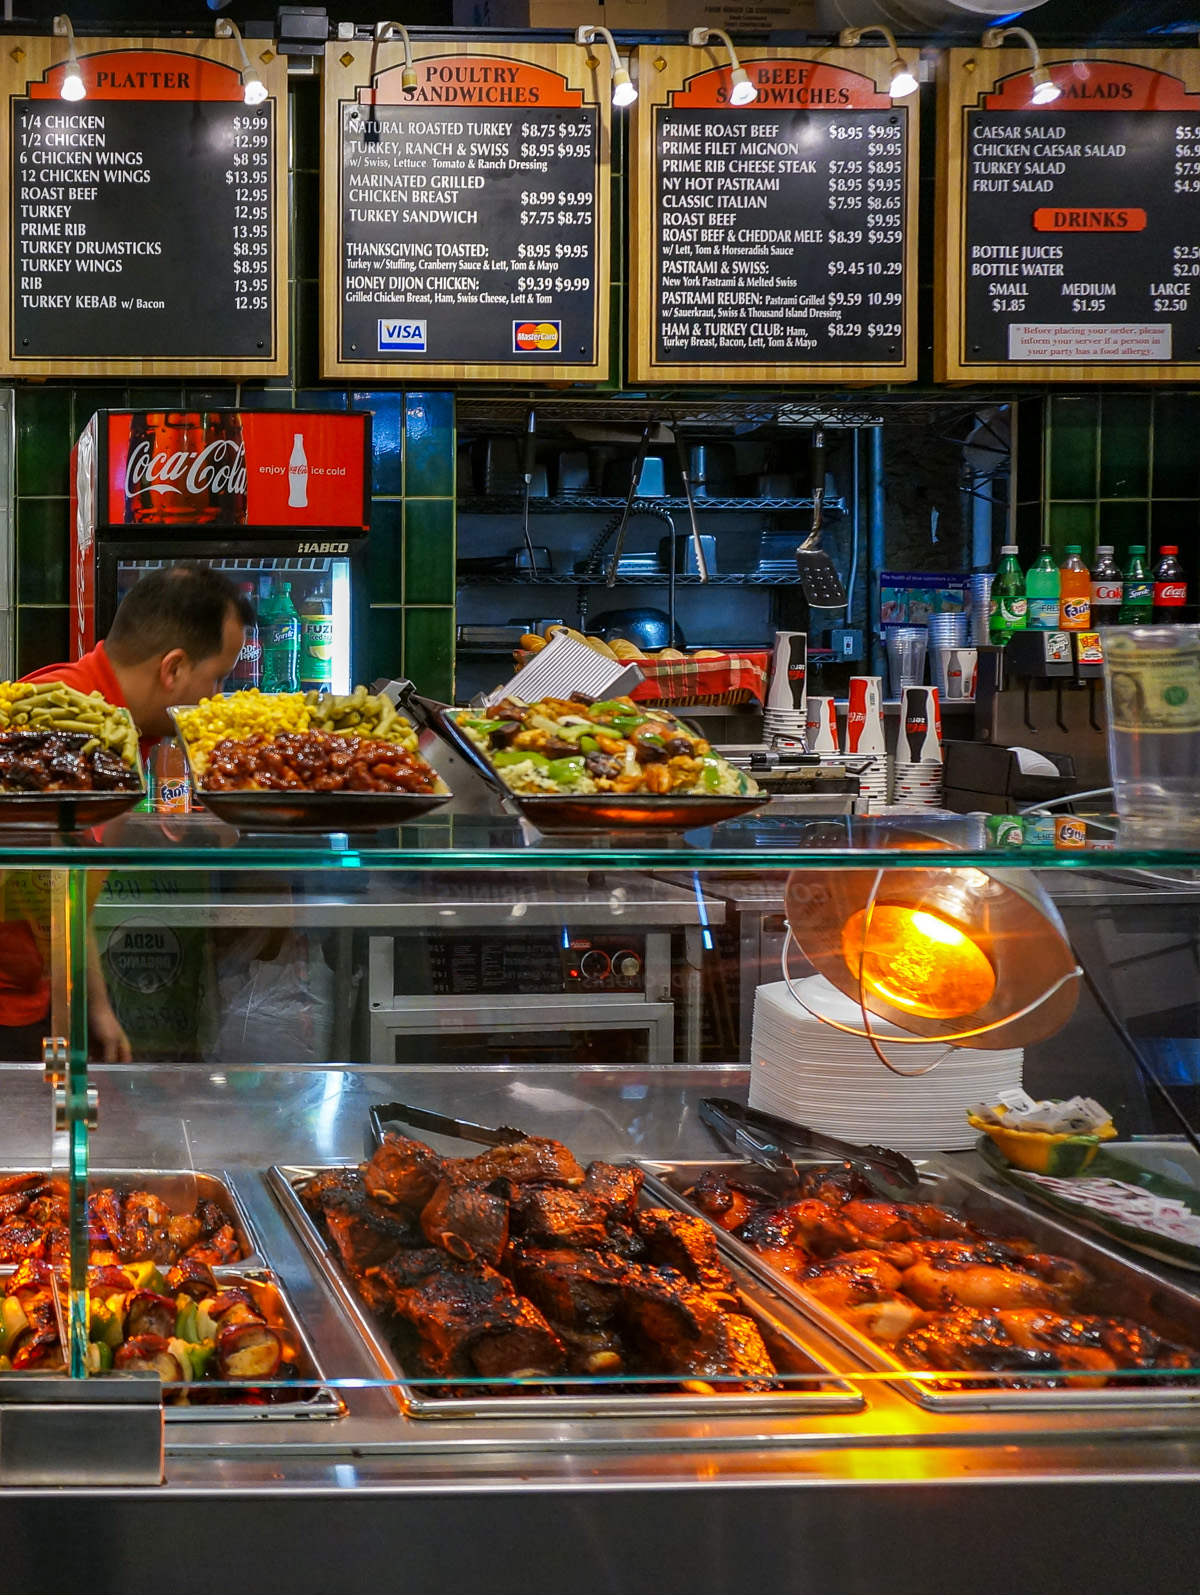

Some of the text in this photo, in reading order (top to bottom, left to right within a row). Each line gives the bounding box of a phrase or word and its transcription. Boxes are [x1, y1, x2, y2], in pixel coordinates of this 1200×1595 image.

[97, 72, 190, 88] PLATTER
[426, 67, 519, 83] POULTRY
[758, 69, 808, 84] BEEF
[402, 87, 539, 102] SANDWICHES
[716, 87, 850, 104] SDWICHES
[21, 115, 268, 130] 1/4 CHICKEN $9.99
[974, 127, 1066, 139] CAESAR SALAD
[974, 144, 1126, 157] CHICKEN CAESAR SALAD
[22, 169, 267, 185] 12 CHICKEN WINGS $13.95
[350, 175, 485, 188] MARINATED GRILLED
[664, 178, 901, 192] NY HOT PASTRAMI $8.95 $9.95
[974, 180, 1054, 192] FRUIT SALAD
[22, 187, 268, 201] ROAST BEEF 12.95
[350, 190, 592, 206] CHICKEN BREAST $8.99 $9.99
[1054, 212, 1128, 227] DRINKS
[21, 241, 268, 256] TURKEY DRUMSTICKS $8.95
[973, 246, 1063, 260] BOTTLE JUICES
[22, 277, 268, 292] RIB 13.95
[347, 276, 386, 289] HONEY
[390, 277, 423, 291] DIJON
[518, 278, 552, 292] $9.39
[556, 278, 590, 292] $9.99
[663, 276, 797, 287] New York Pastrami & Melted Swiss
[990, 284, 1190, 296] SMALL MEDIUM LARGE
[22, 295, 268, 309] TURKEY KEBAB w/ Bacon 12.95
[993, 299, 1187, 312] $1.85 $1.95 $2.50
[386, 325, 422, 339] VISA
[517, 332, 557, 342] MasterCard
[1054, 327, 1085, 336] placing
[1088, 328, 1108, 336] your
[1139, 328, 1165, 336] please
[1052, 338, 1072, 346] your
[1120, 338, 1149, 346] person
[1027, 348, 1046, 356] your
[1050, 348, 1072, 356] party
[125, 440, 248, 498] Coca-Cola
[259, 465, 346, 475] enjoy ice cold
[298, 543, 349, 553] HABCO
[1129, 589, 1150, 599] Sprite
[274, 630, 294, 641] Sprite
